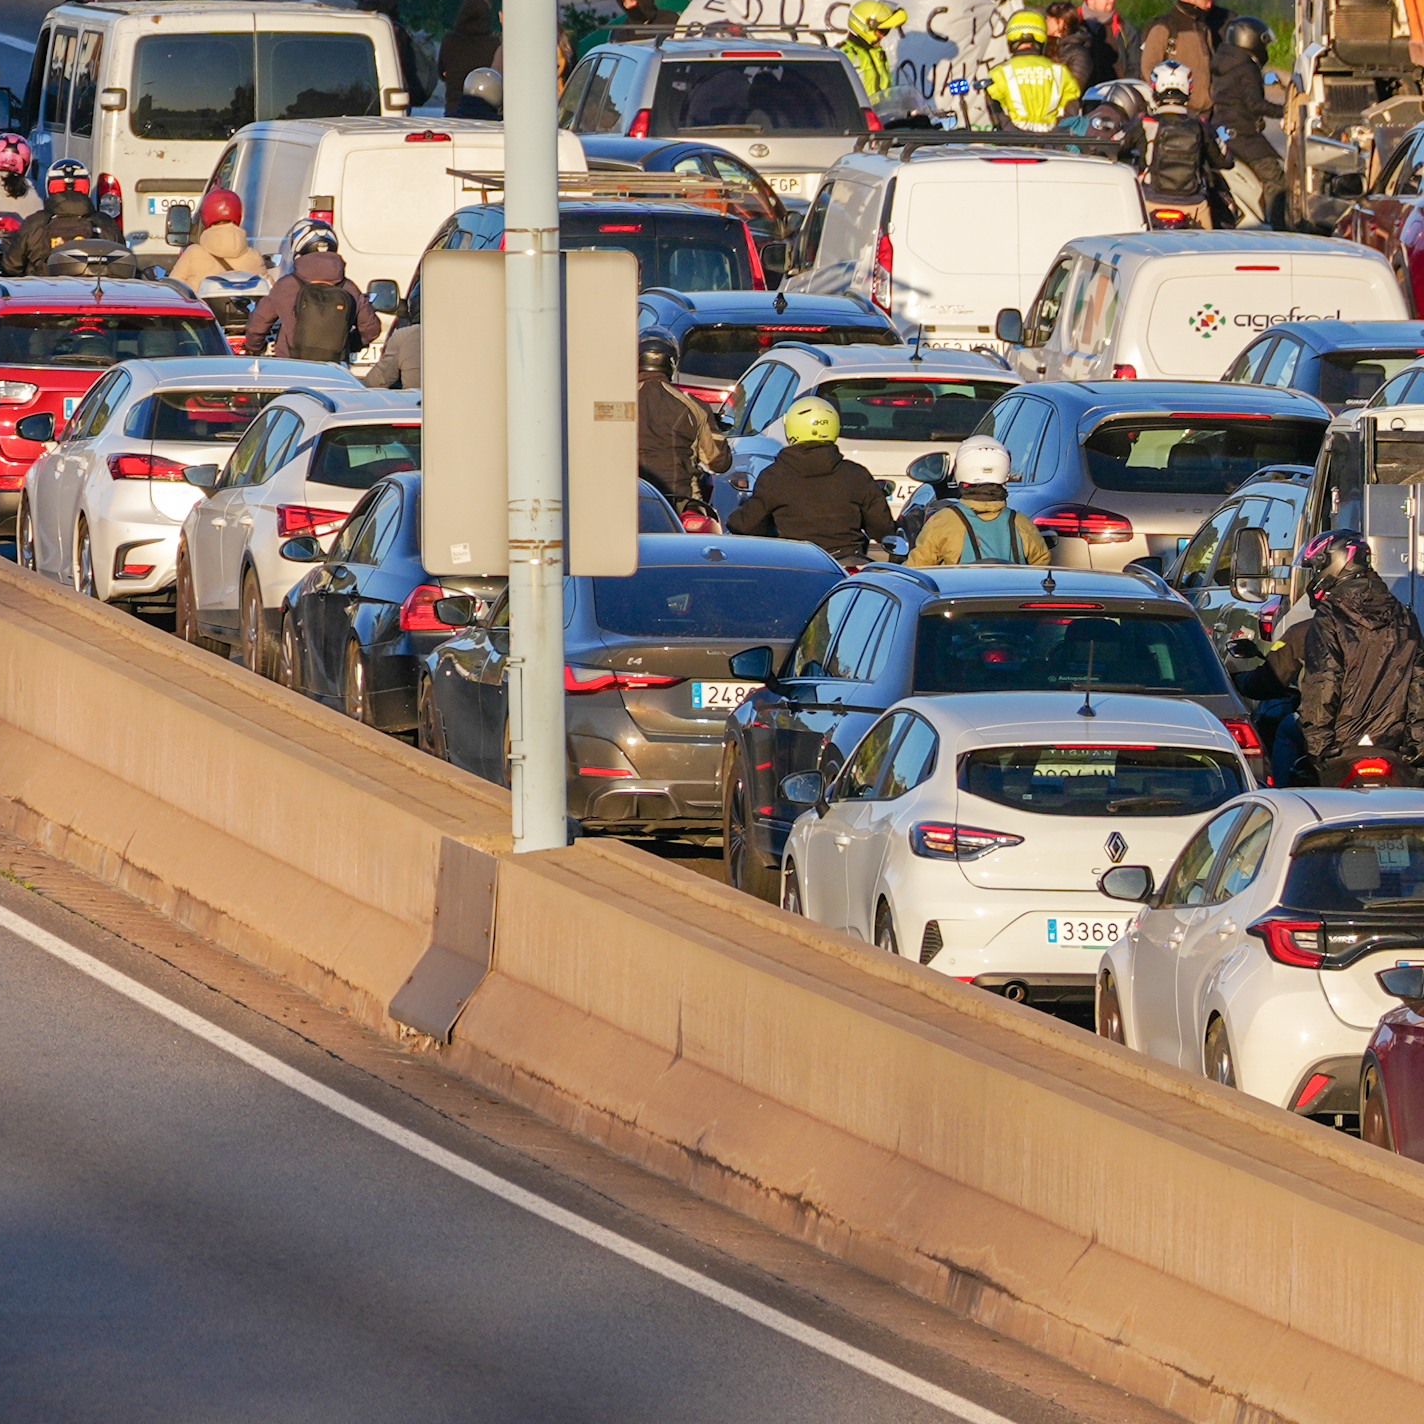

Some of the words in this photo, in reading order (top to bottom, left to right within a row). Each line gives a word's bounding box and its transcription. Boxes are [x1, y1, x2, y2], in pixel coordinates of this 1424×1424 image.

[361, 346, 383, 361] 21
[1058, 675, 1100, 683] Autopodum
[1048, 749, 1112, 757] TIGUAN
[1063, 921, 1119, 942] 3368
